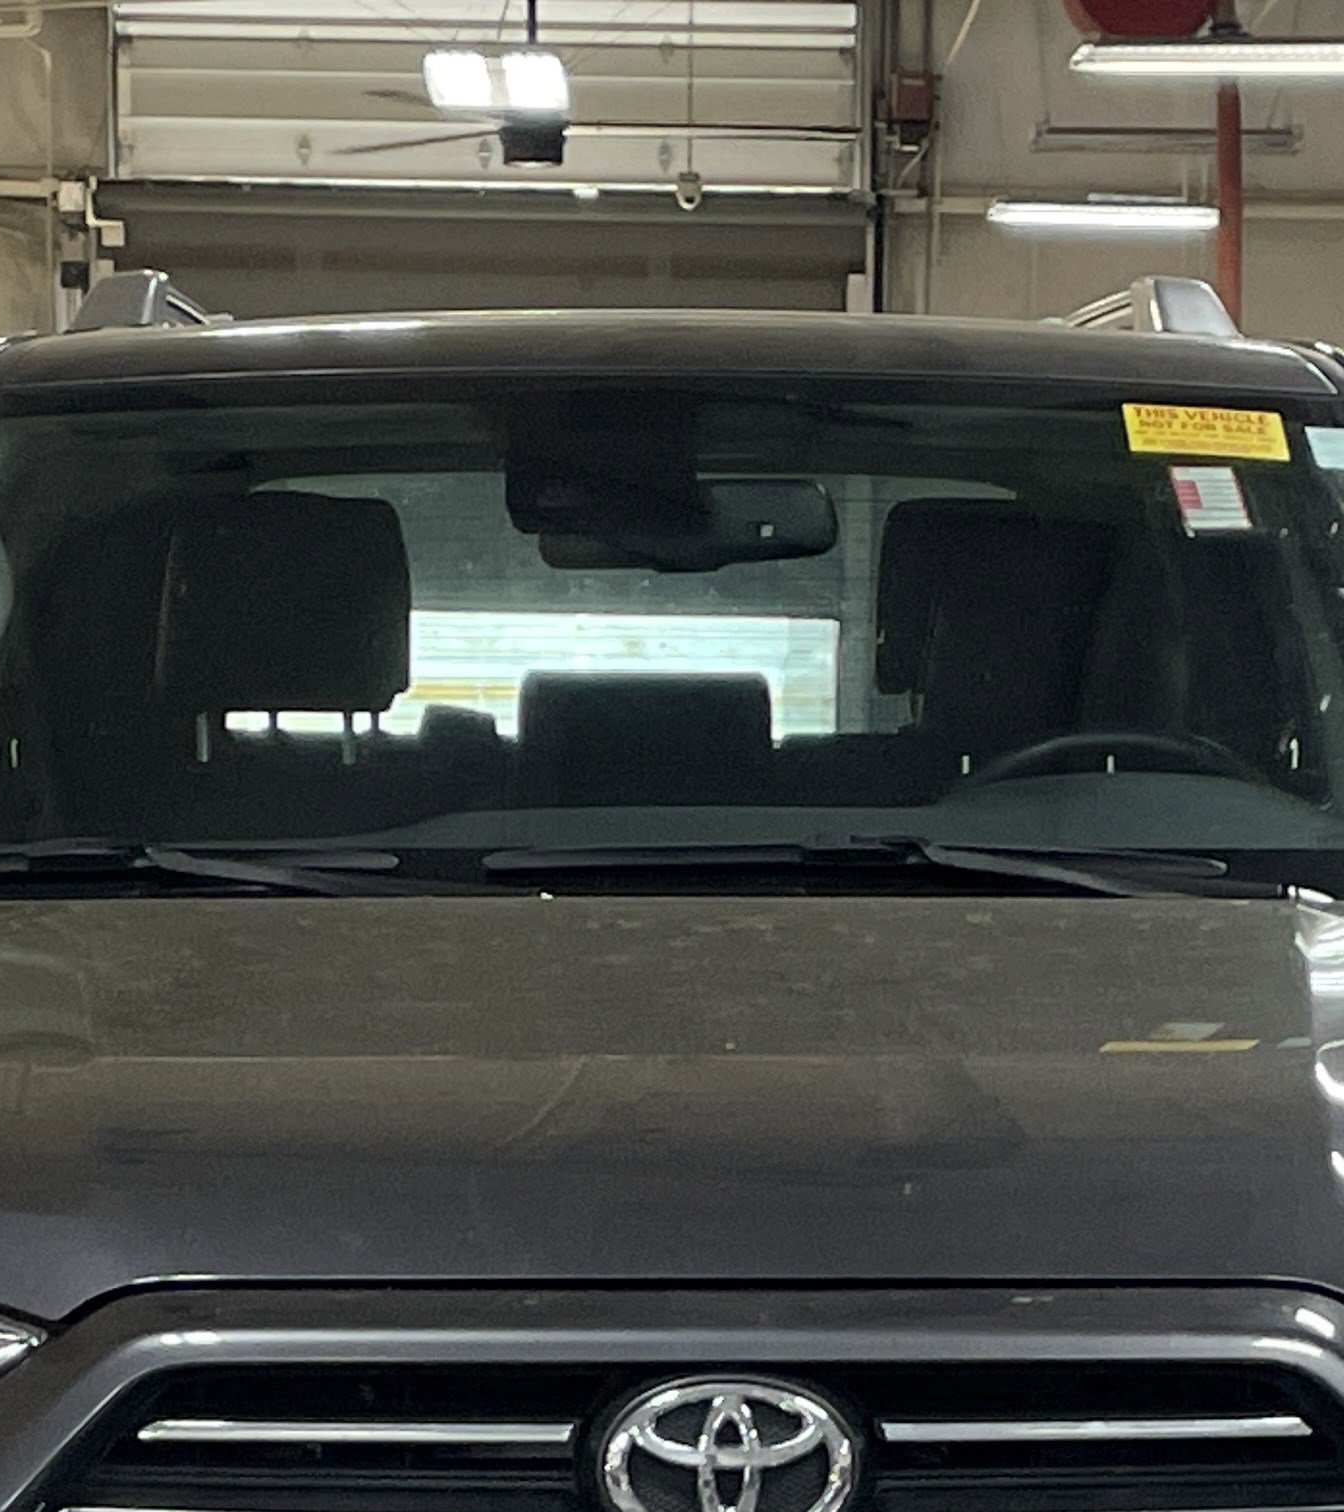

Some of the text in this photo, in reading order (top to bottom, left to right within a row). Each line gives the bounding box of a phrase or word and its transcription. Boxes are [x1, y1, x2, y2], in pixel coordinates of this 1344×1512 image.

[1132, 405, 1269, 425] THIS VEHICLE
[1138, 419, 1267, 435] NOT FOR SALE
